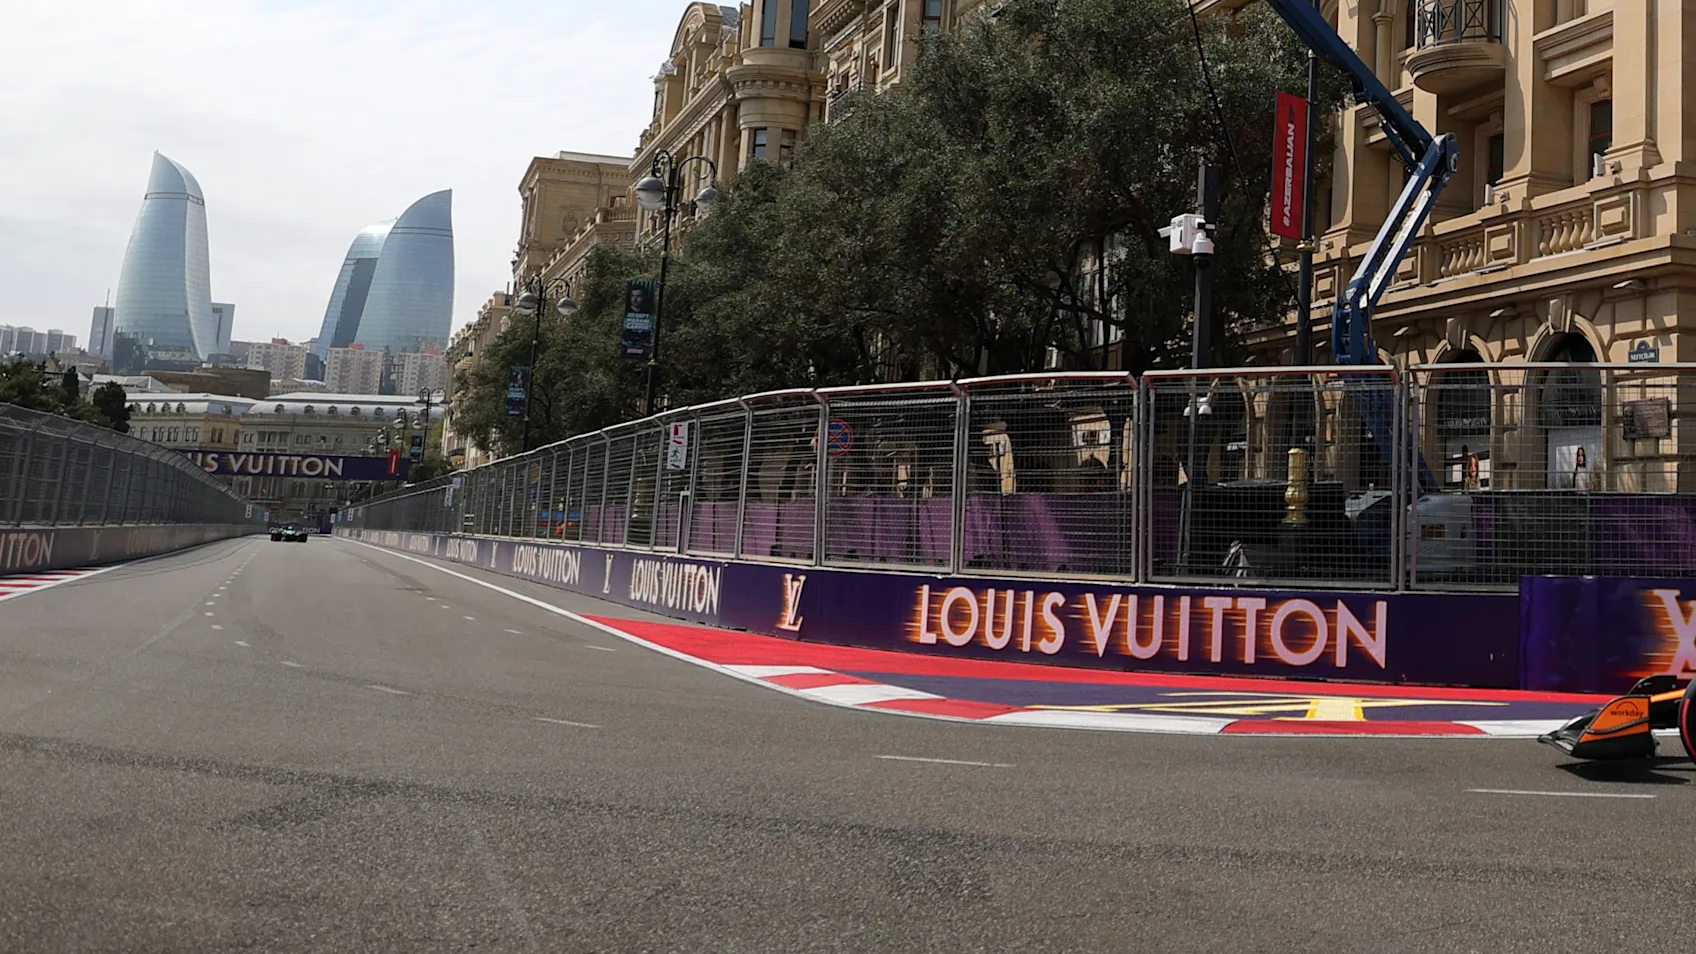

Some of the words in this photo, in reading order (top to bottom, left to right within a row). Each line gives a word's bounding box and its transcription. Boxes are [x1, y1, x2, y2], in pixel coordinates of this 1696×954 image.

[1283, 122, 1295, 227] #AZERBAIJAN
[228, 454, 344, 477] VUITTON
[512, 544, 537, 576] LOUIS
[538, 547, 582, 585] VUITTON
[630, 558, 660, 605] LOUIS
[661, 560, 721, 616] VUITTON
[918, 583, 1066, 655] LOUIS
[1084, 592, 1388, 670] VUITTON
[1610, 709, 1644, 719] workday
